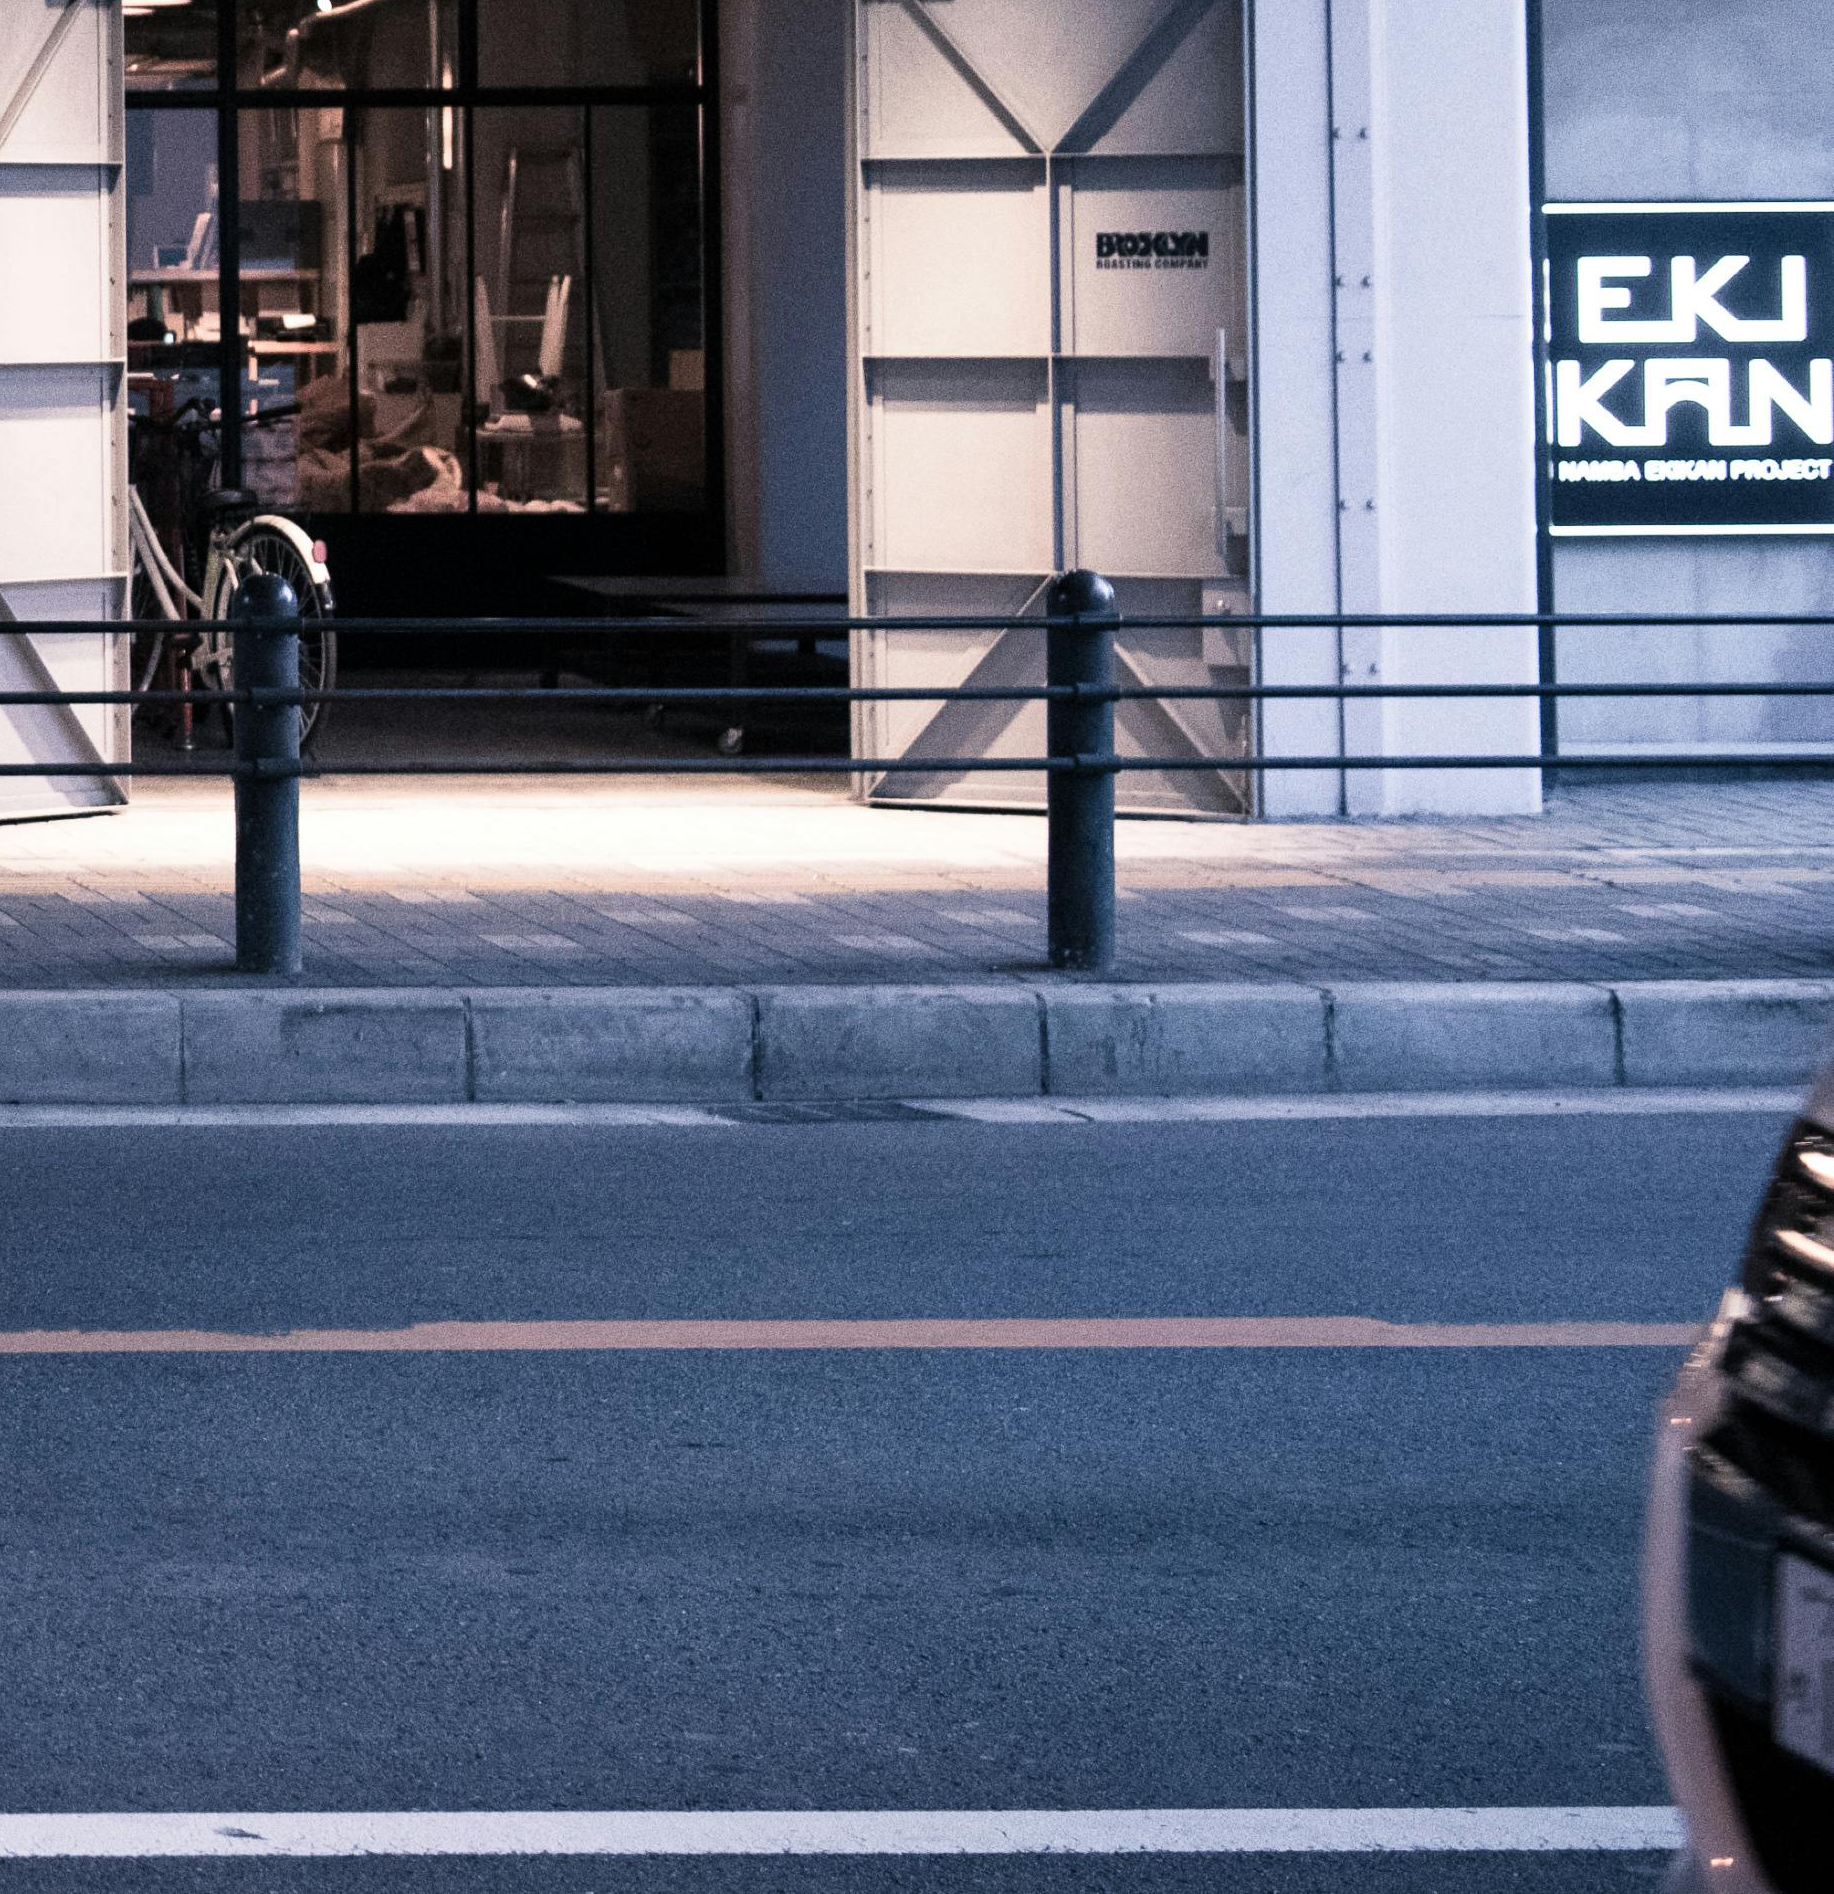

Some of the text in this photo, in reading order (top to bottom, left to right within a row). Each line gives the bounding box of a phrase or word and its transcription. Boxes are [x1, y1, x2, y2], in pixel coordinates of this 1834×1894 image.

[1577, 255, 1807, 343] EKI
[1556, 358, 1833, 447] KAN
[1557, 458, 1833, 482] NAMBA EKIKAN PROJECT
